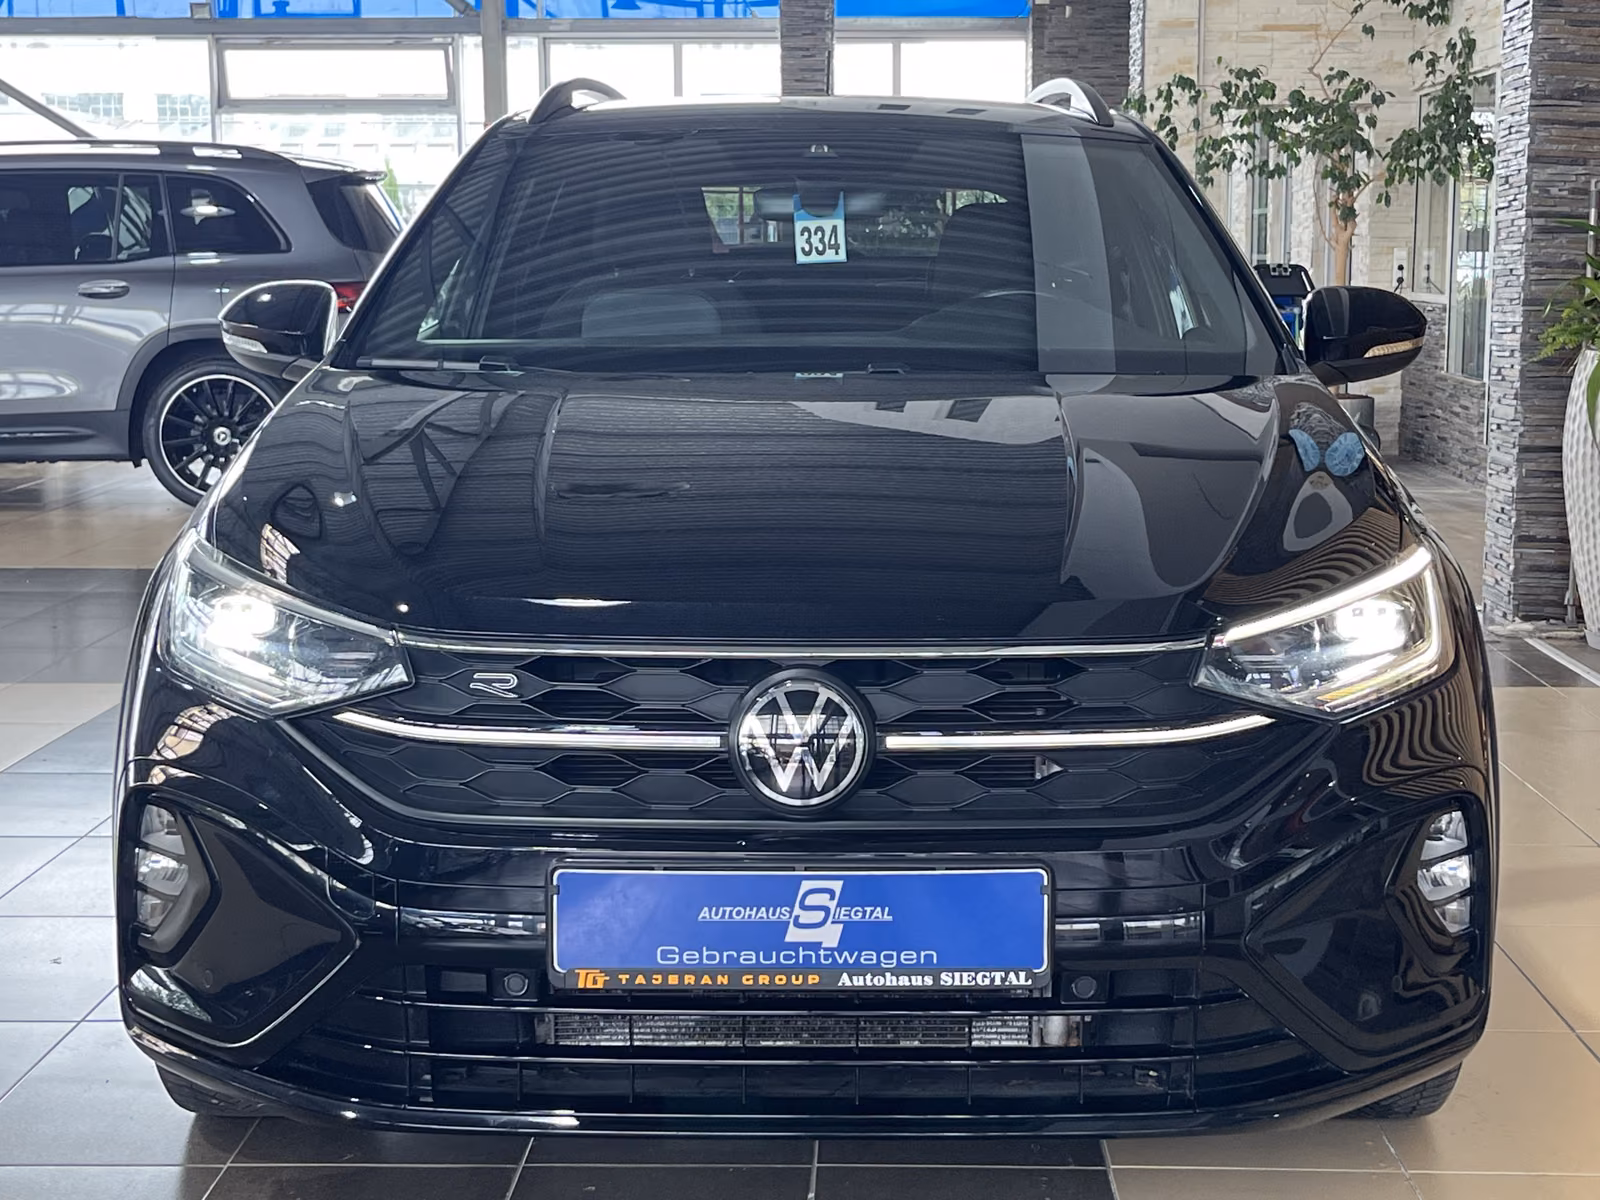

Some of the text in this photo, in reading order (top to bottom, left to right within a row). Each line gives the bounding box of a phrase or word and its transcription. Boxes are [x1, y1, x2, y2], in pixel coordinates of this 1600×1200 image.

[800, 225, 841, 257] 334
[698, 906, 790, 921] AUTOHAUS
[656, 946, 938, 968] Gebrauchtwagen
[742, 974, 820, 985] GROUP
[837, 971, 934, 987] Autohaus
[940, 971, 1032, 987] SIEGTAL
